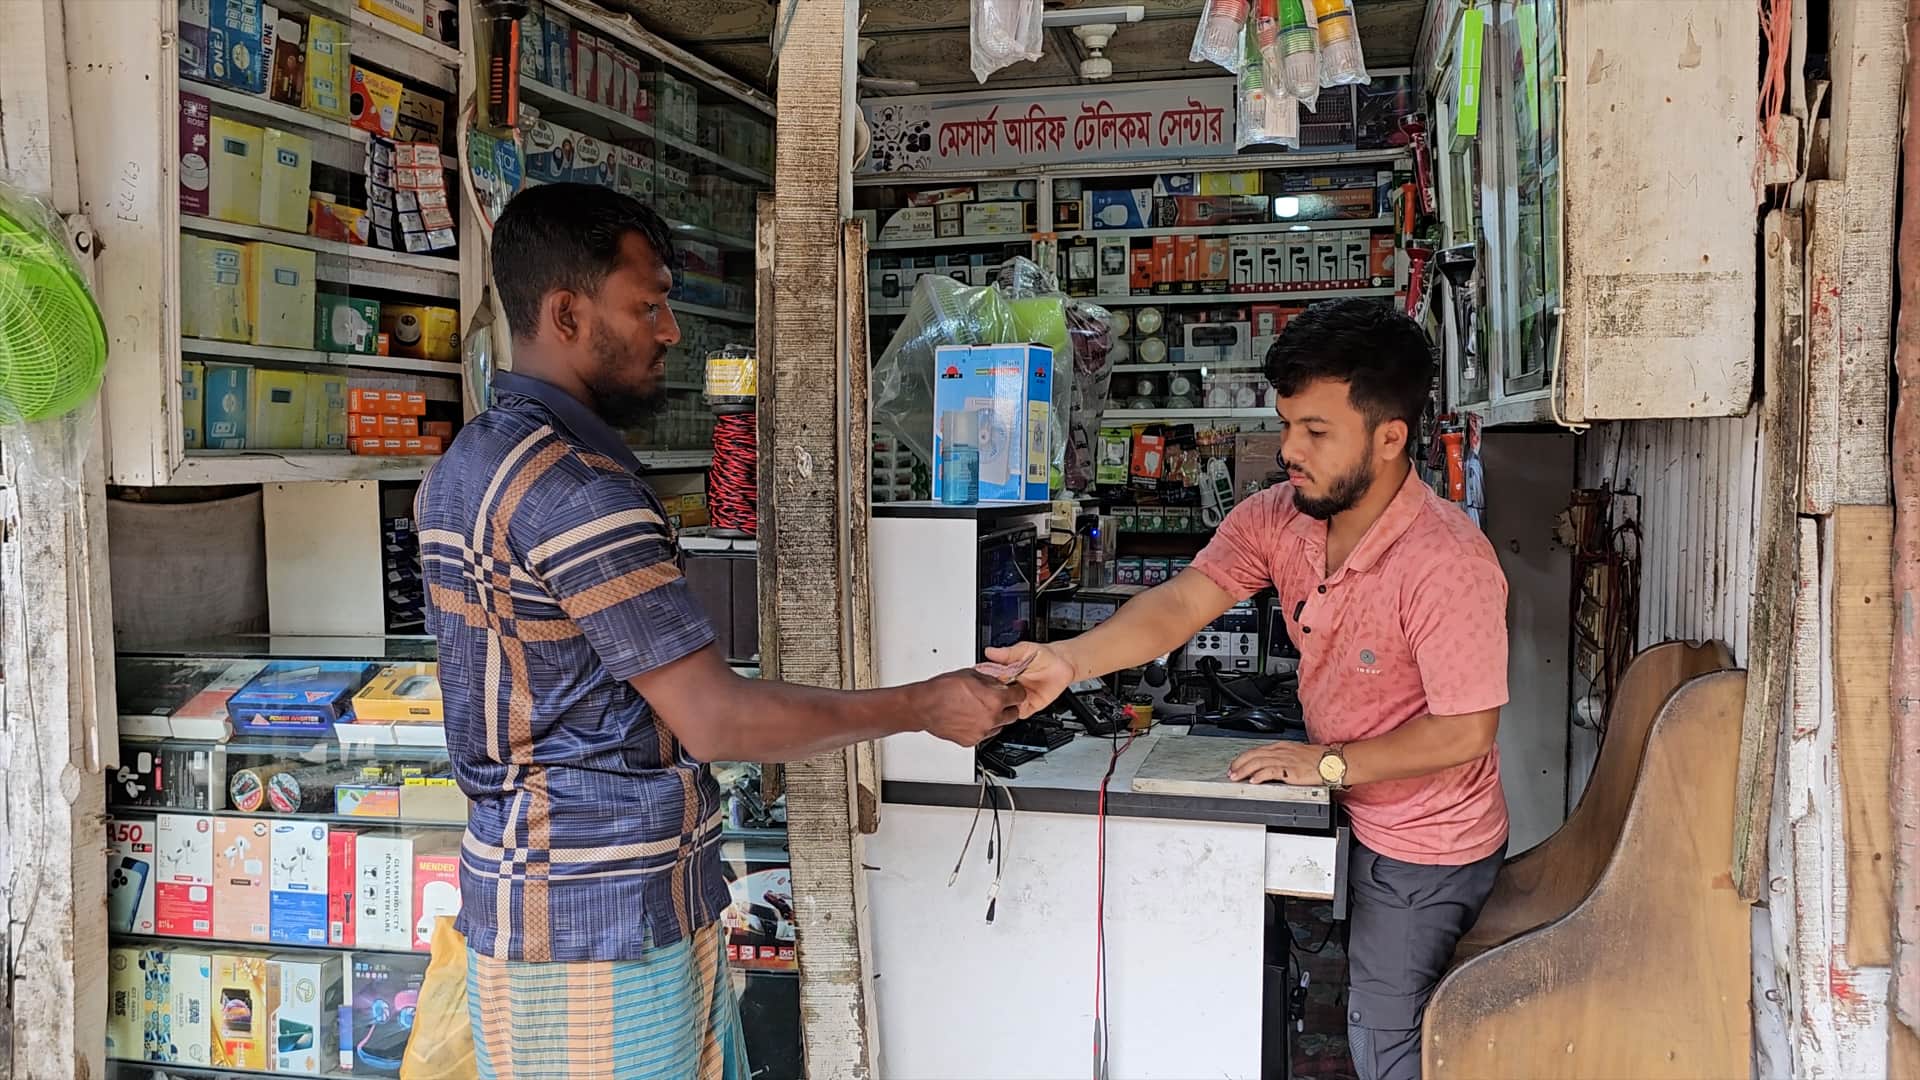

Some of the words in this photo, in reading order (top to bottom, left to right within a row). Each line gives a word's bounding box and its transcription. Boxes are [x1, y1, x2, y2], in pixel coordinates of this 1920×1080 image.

[263, 23, 274, 46] ONE
[938, 105, 999, 158] মেসার্স
[1002, 103, 1068, 155] আরিফ
[1074, 100, 1152, 153] টেলিকম
[1159, 96, 1225, 147] সেন্টার
[107, 823, 142, 842] A50
[419, 862, 456, 872] MENDED
